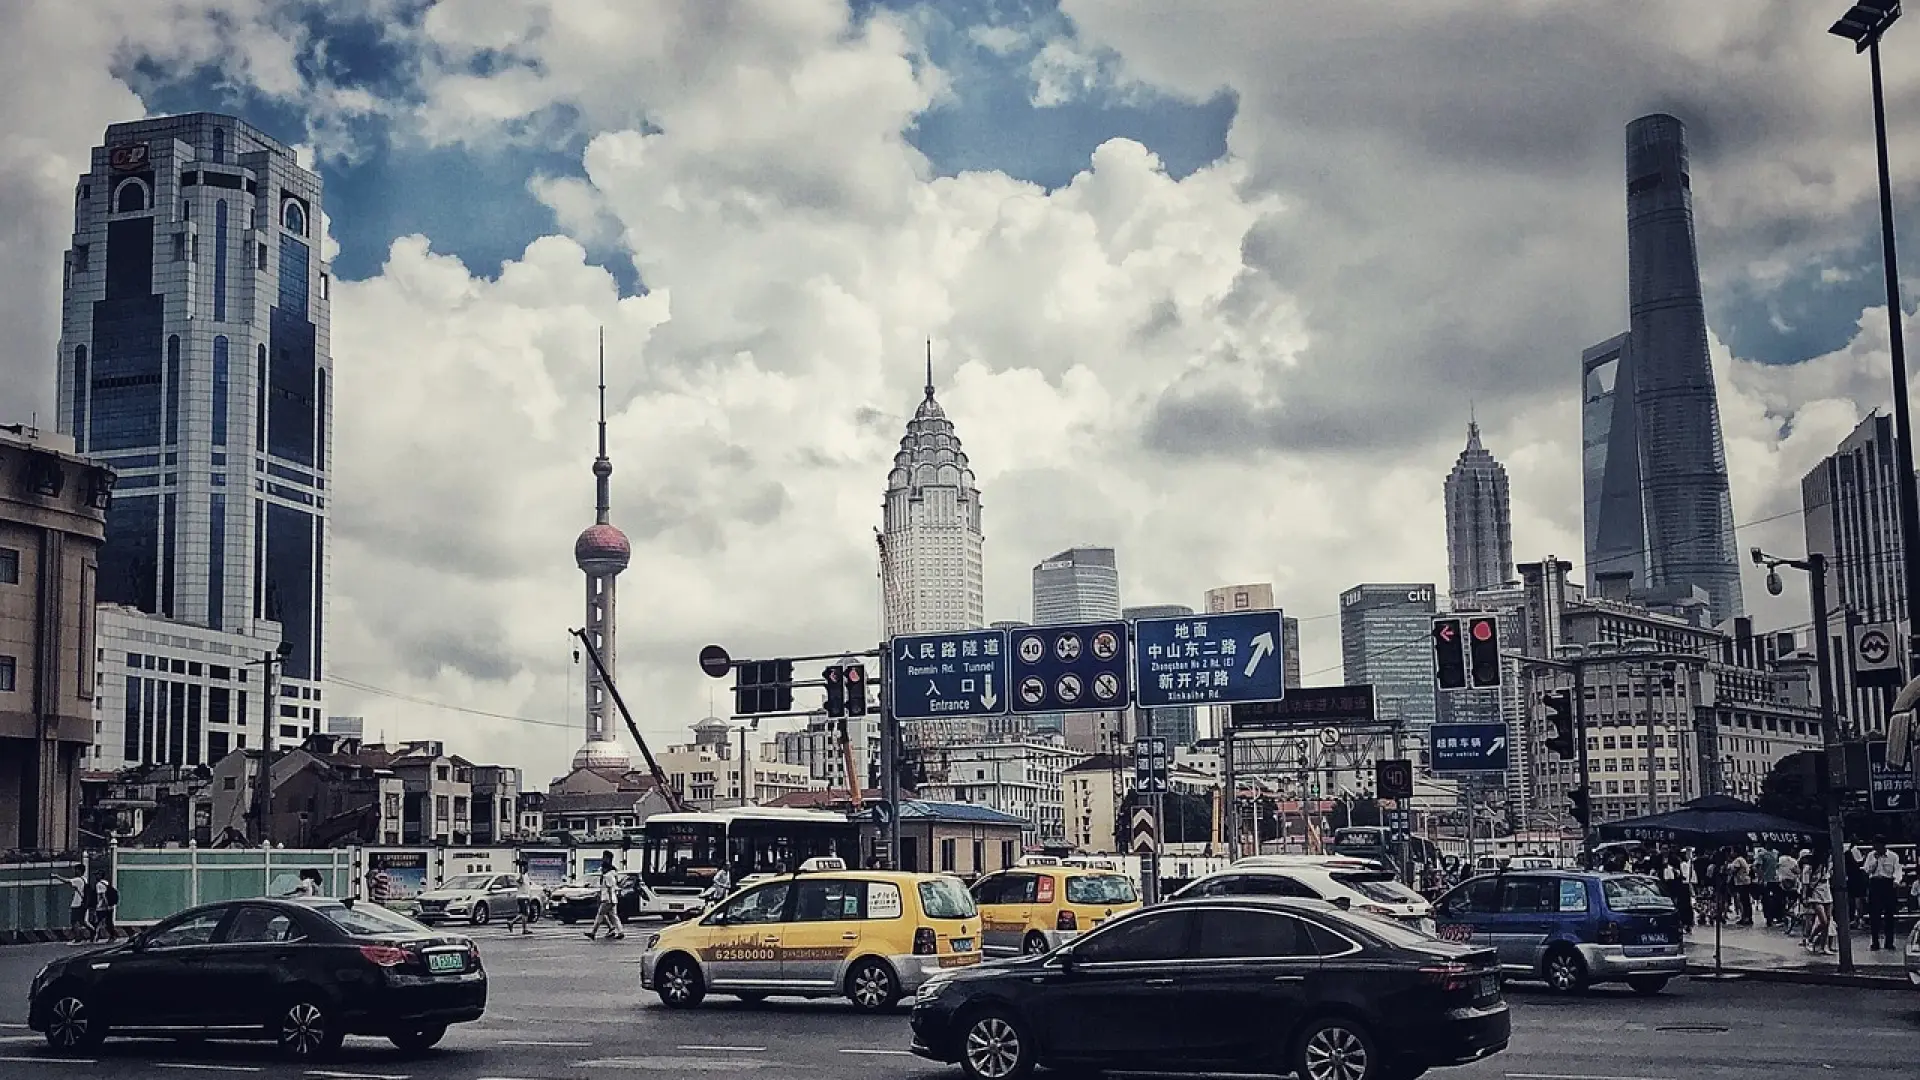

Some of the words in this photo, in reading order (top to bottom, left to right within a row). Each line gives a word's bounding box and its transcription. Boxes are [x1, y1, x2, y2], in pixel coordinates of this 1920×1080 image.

[1175, 622, 1207, 639] 地面
[899, 639, 999, 661] 人民路隧道
[1023, 644, 1039, 655] 40
[1148, 639, 1237, 659] 中山东二路
[963, 661, 995, 672] Tunnel
[1158, 670, 1229, 690] 新开河路
[926, 679, 975, 697] 入口
[929, 699, 970, 712] Entrance
[1635, 829, 1665, 840] POLICE
[1761, 831, 1800, 844] POLICE
[715, 949, 775, 960] 62580000
